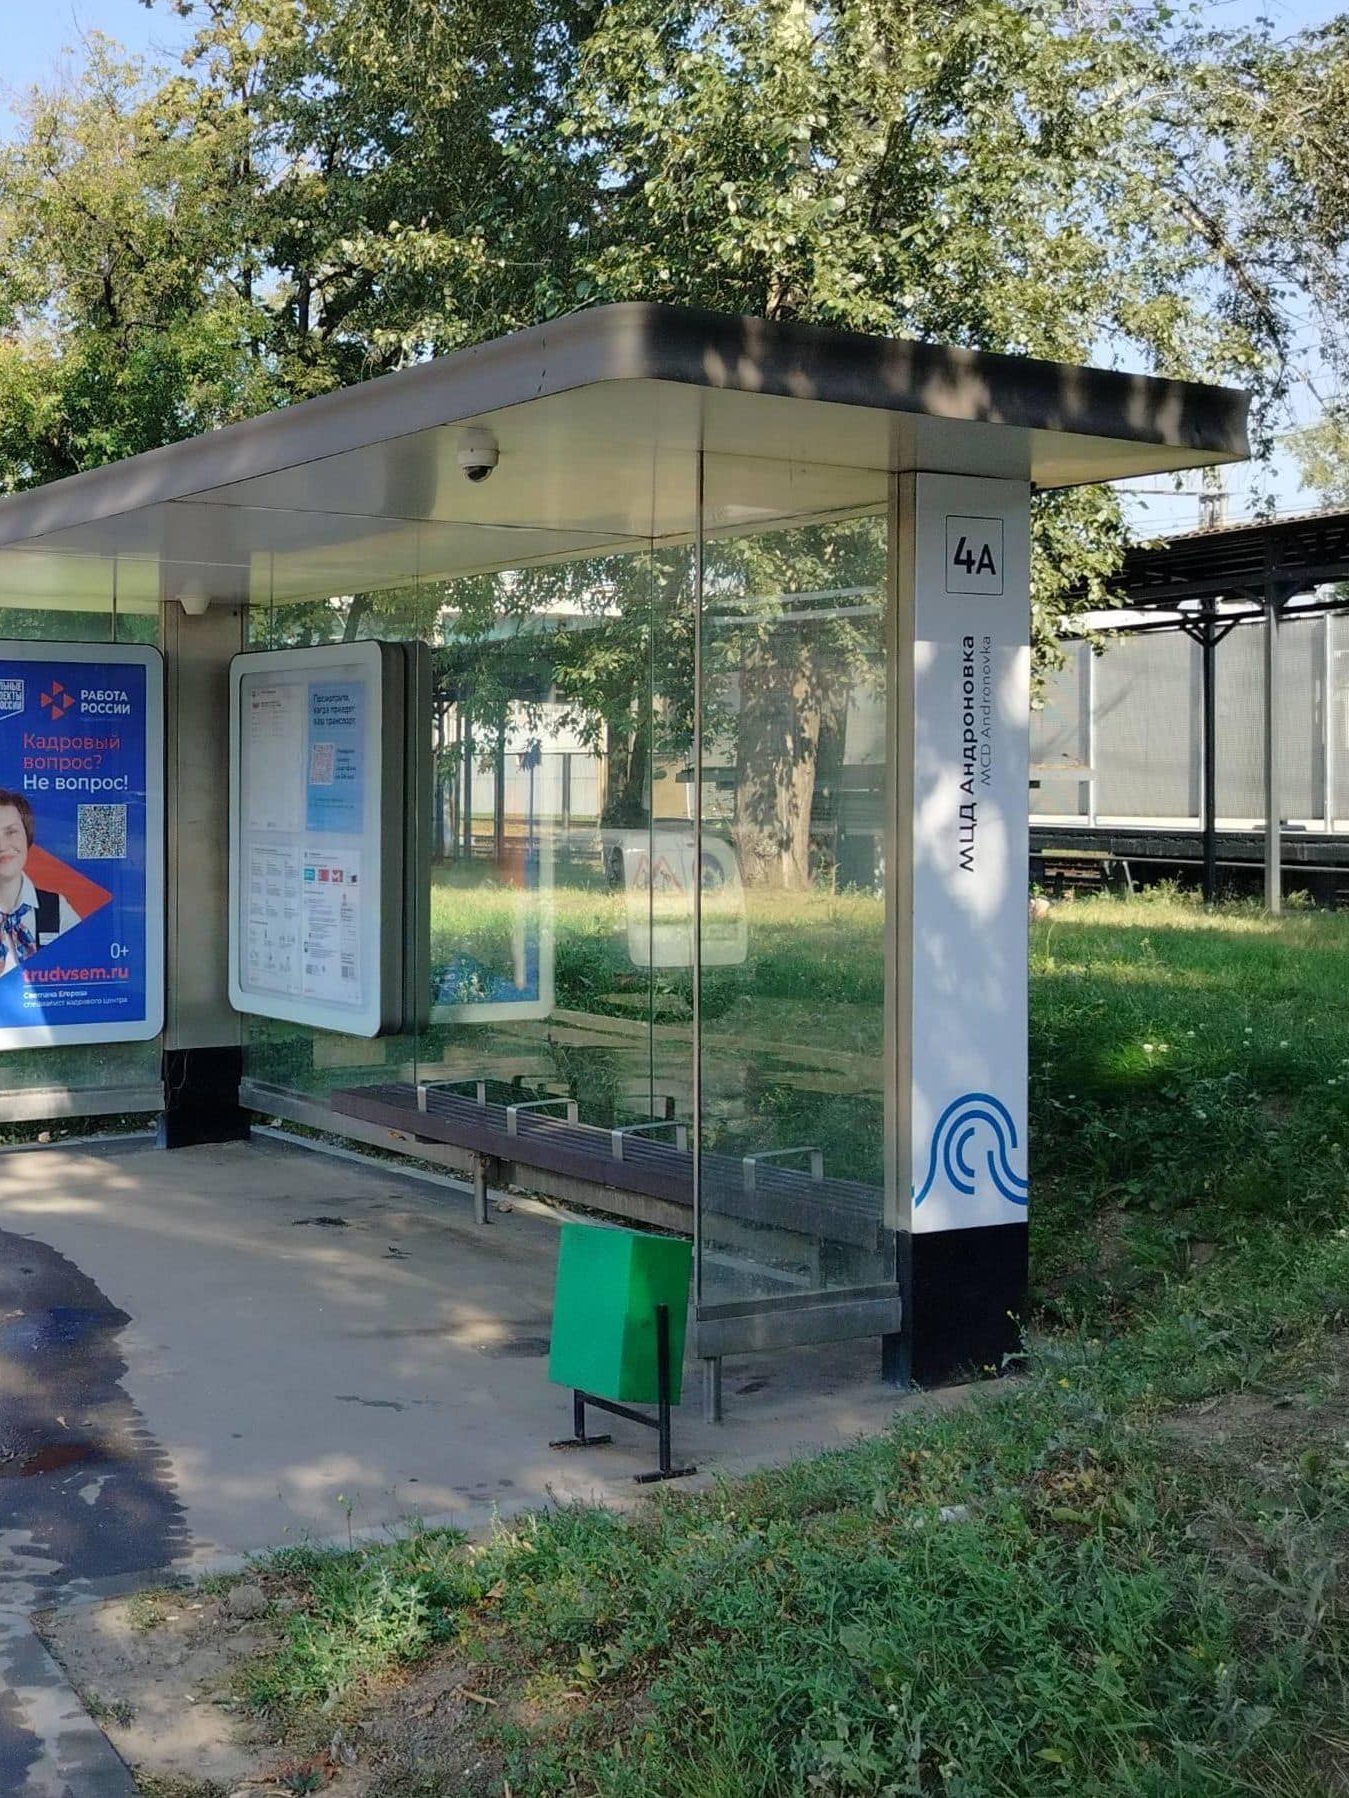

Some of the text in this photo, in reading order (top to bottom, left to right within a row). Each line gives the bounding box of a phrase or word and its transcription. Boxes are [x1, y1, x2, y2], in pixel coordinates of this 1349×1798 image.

[953, 536, 996, 576] 4А
[80, 689, 128, 702] РАБОТА
[80, 702, 131, 715] РОССИИ
[979, 636, 992, 787] MCD Andronovka
[23, 732, 121, 753] Кадровый
[23, 754, 102, 772] вопрос?
[959, 635, 978, 873] МЦД Андроновка
[23, 773, 129, 794] Не вопрос!
[110, 942, 129, 960] 0+
[23, 966, 129, 983] trudvsem.ru
